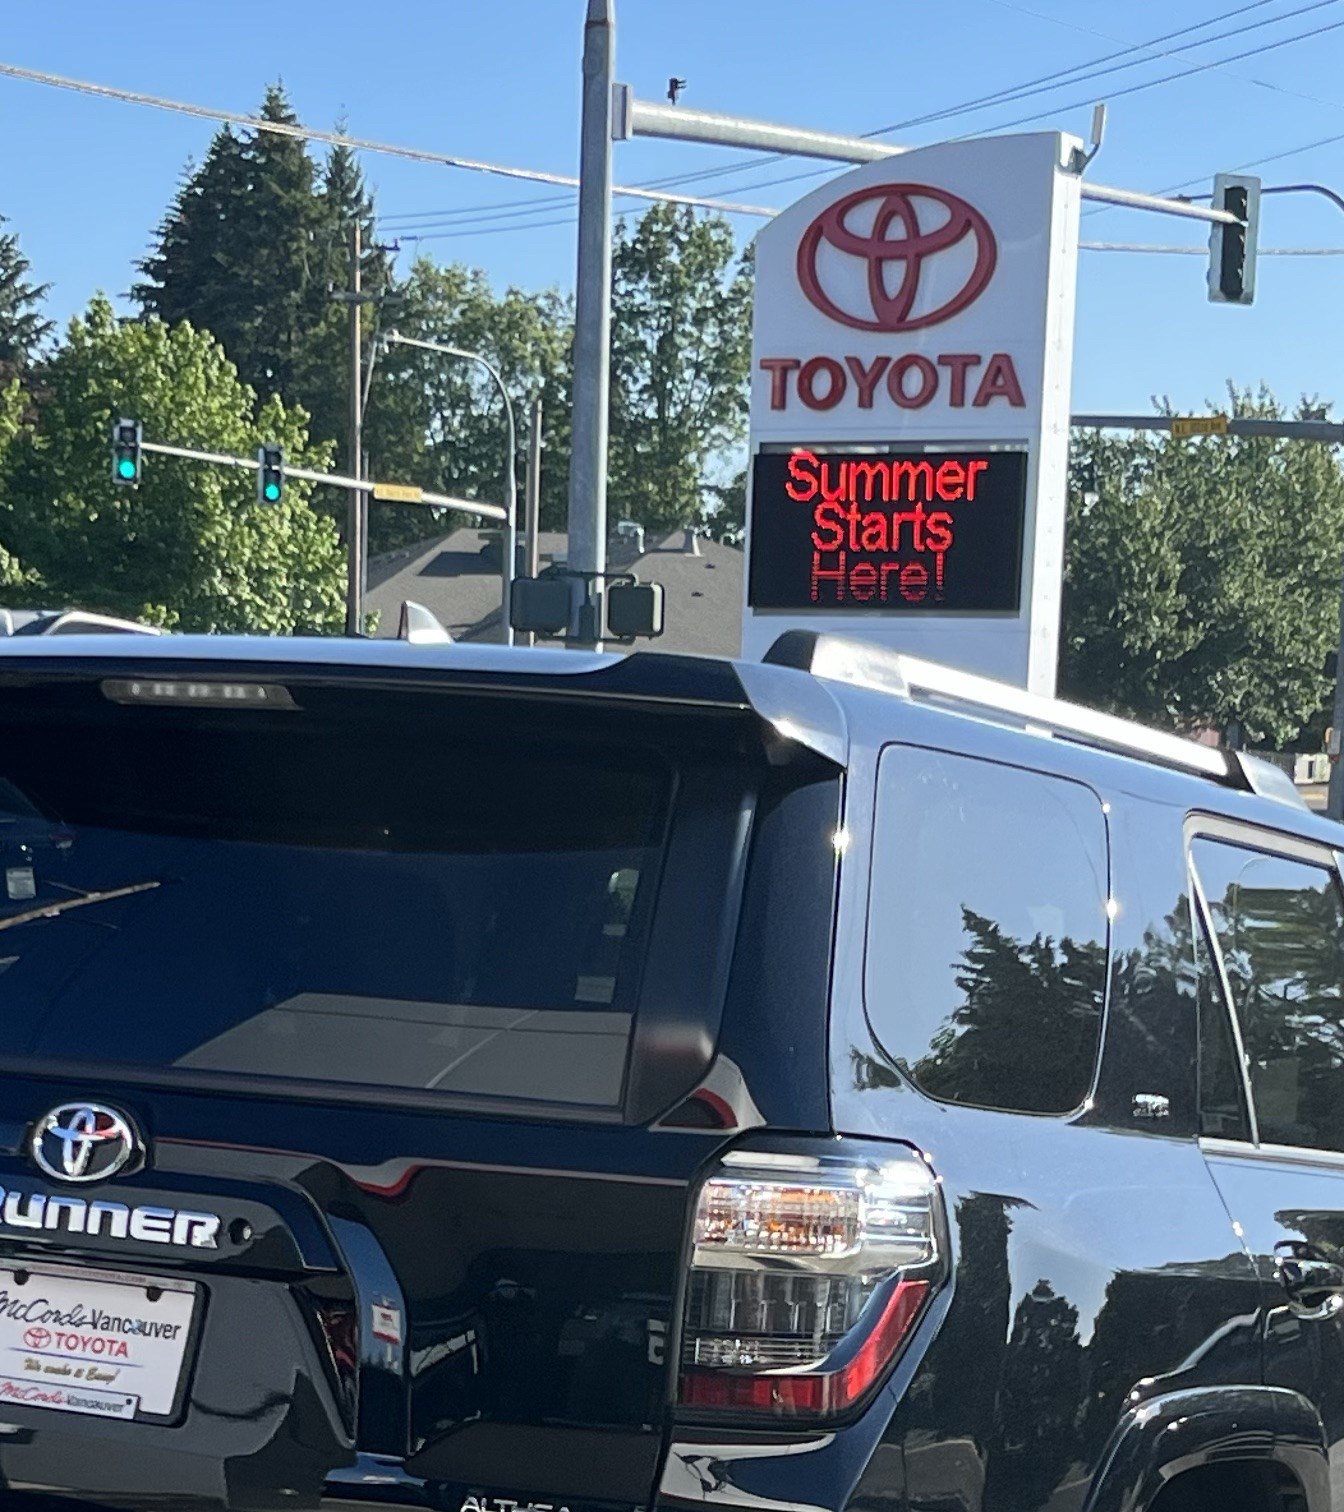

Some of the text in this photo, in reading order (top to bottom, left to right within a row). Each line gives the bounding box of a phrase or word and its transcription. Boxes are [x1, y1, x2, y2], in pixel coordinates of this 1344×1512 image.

[759, 352, 1027, 412] TOYOTA
[785, 450, 989, 502] Summer
[810, 500, 954, 553] Starts
[810, 550, 946, 602] Here!
[55, 1331, 130, 1359] TOYOTA
